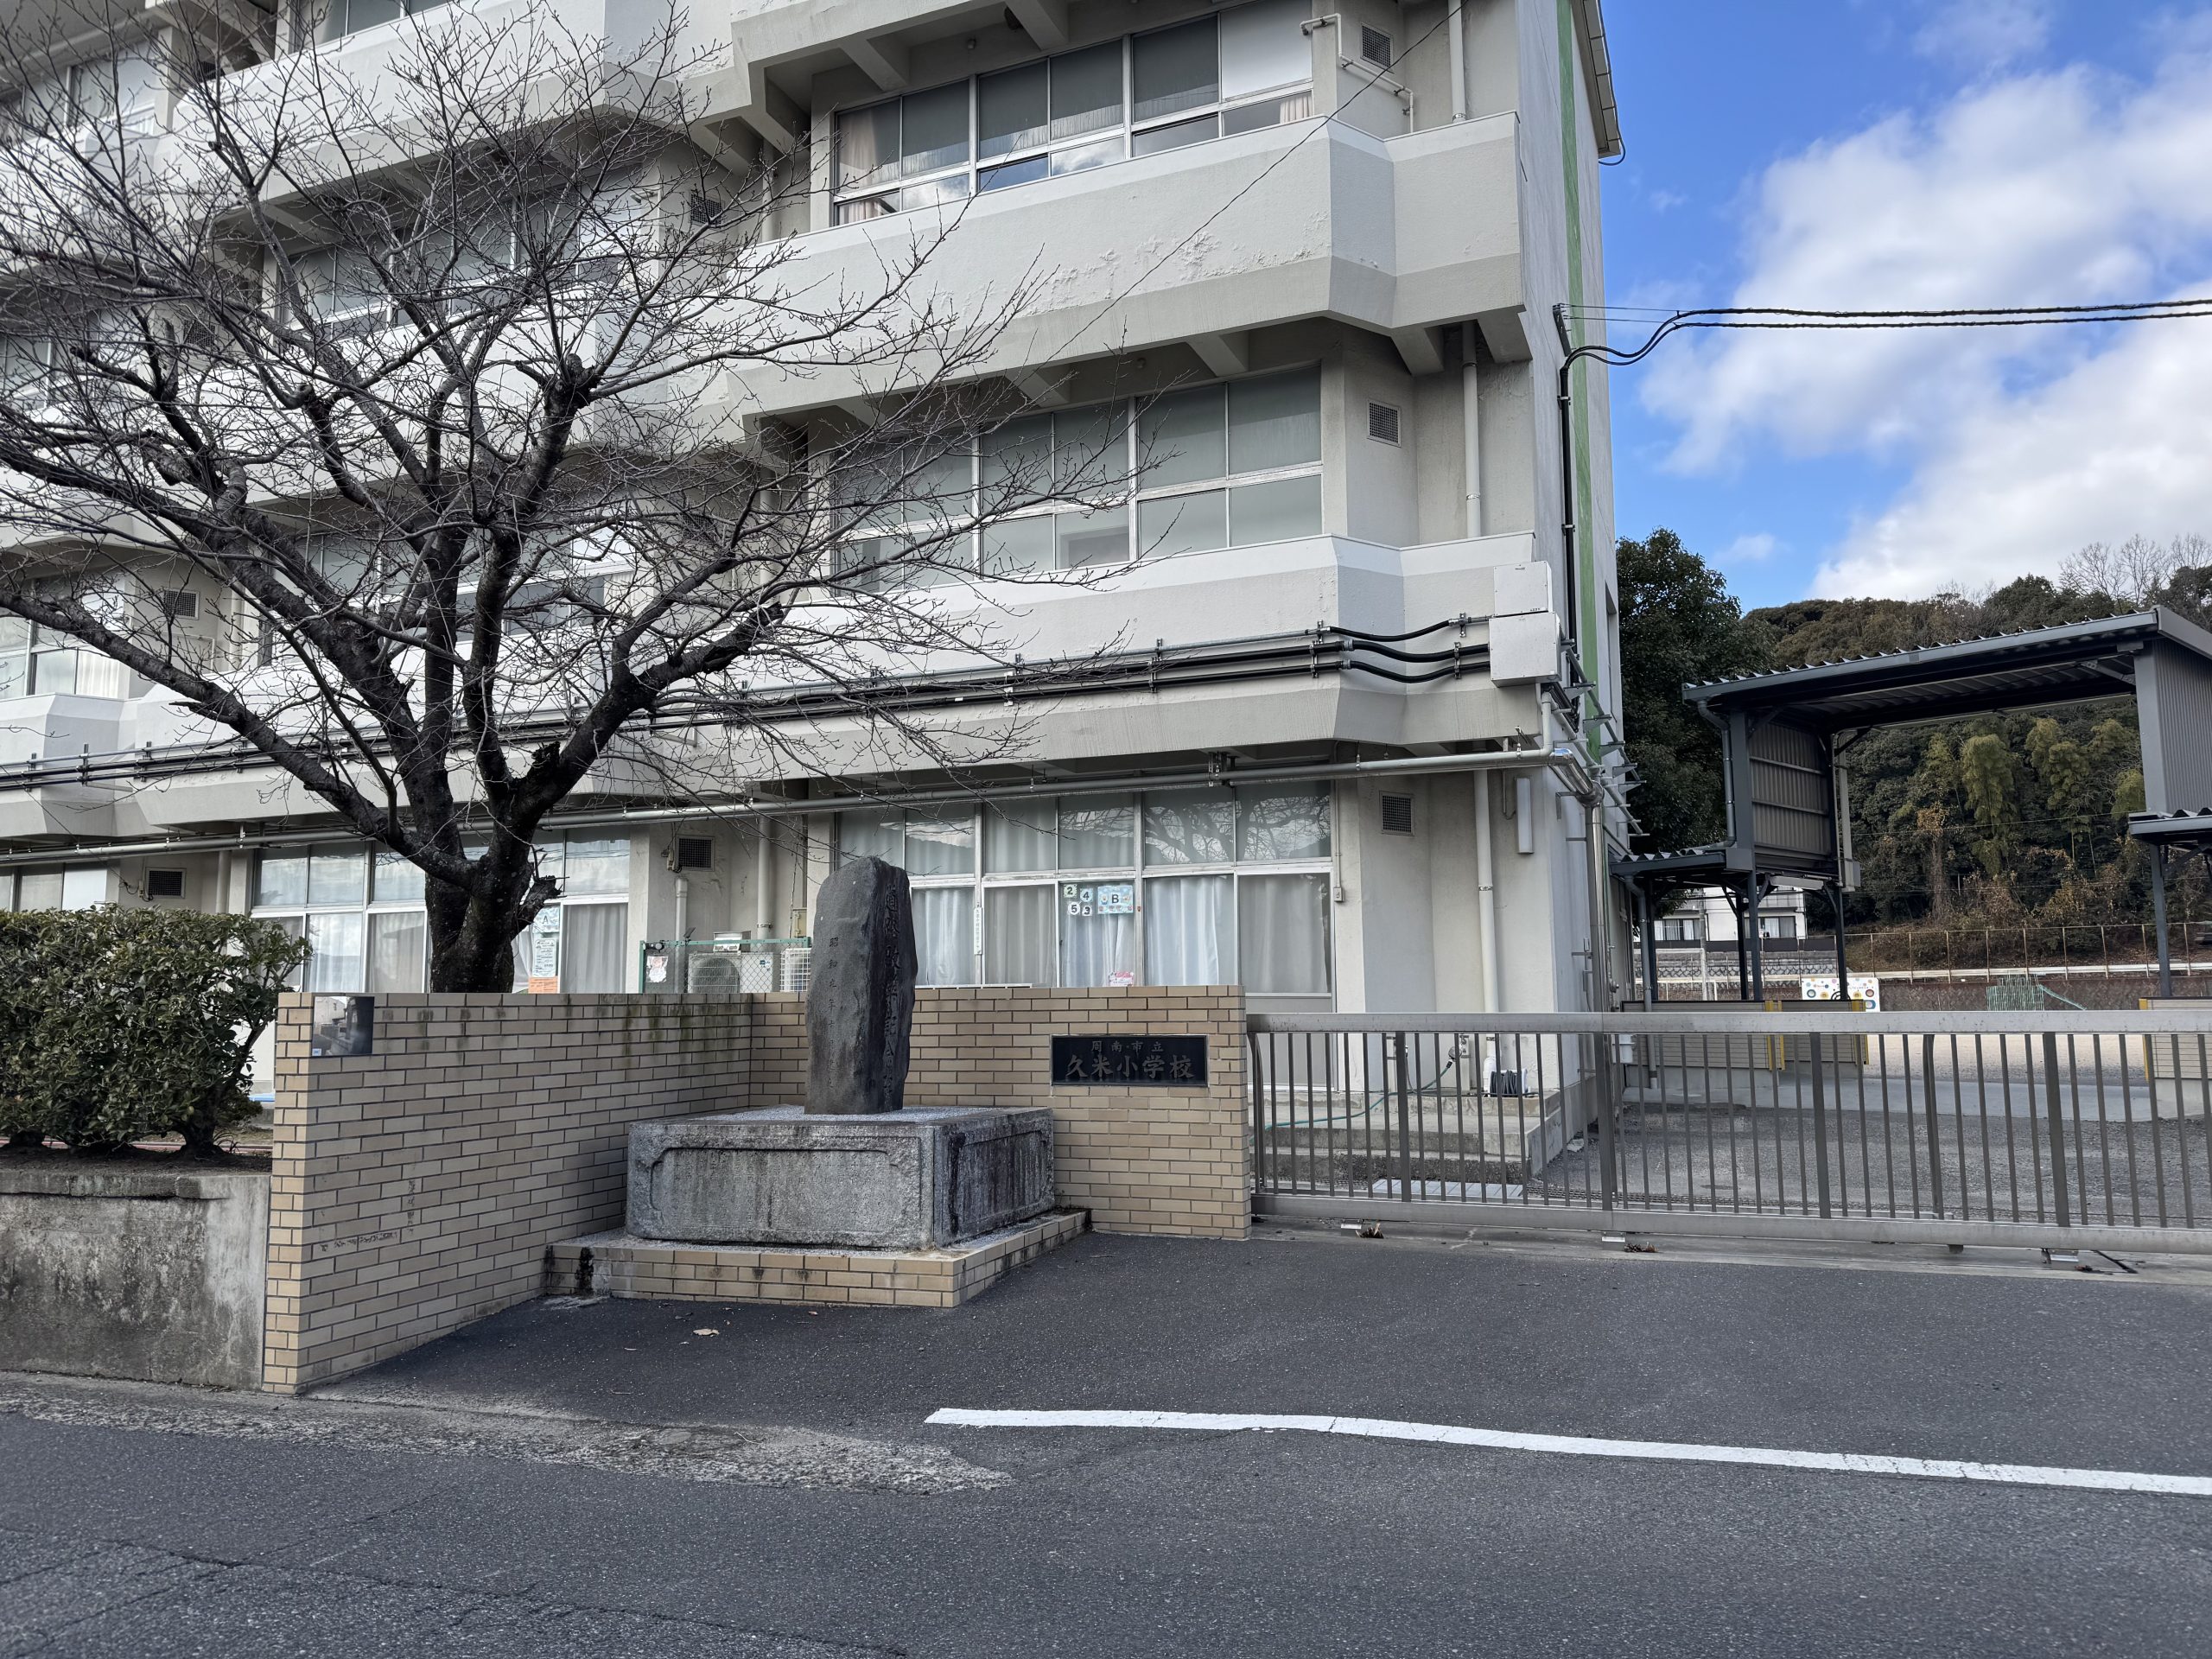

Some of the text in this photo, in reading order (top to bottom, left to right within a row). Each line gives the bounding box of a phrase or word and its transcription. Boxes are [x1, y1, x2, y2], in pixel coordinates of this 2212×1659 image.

[1066, 887, 1073, 895] 2
[1083, 891, 1090, 900] 4
[1111, 893, 1119, 904] B
[1071, 904, 1077, 913] 5
[1084, 906, 1090, 915] 3
[1090, 1039, 1164, 1053] 周南市立
[1065, 1053, 1194, 1079] 久米小学校
